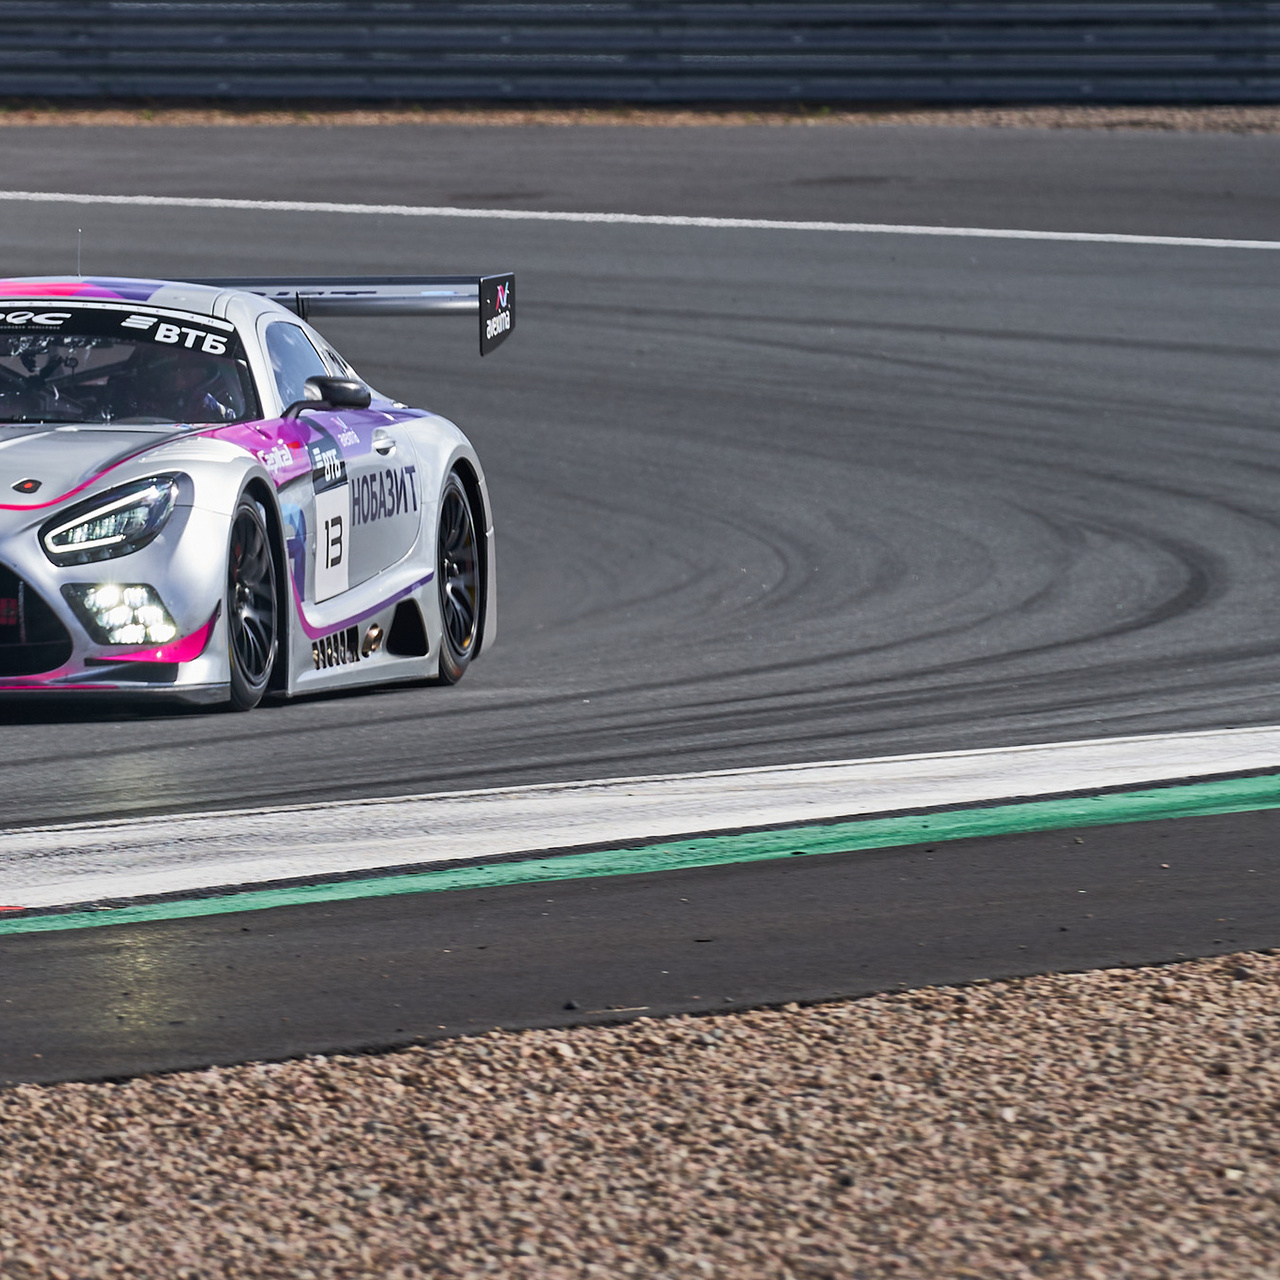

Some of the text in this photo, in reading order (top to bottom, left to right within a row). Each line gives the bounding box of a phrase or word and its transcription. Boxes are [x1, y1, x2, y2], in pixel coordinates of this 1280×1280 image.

[154, 322, 228, 355] ВТБ
[351, 465, 418, 527] НОБАЗИТ
[324, 515, 343, 569] 13
